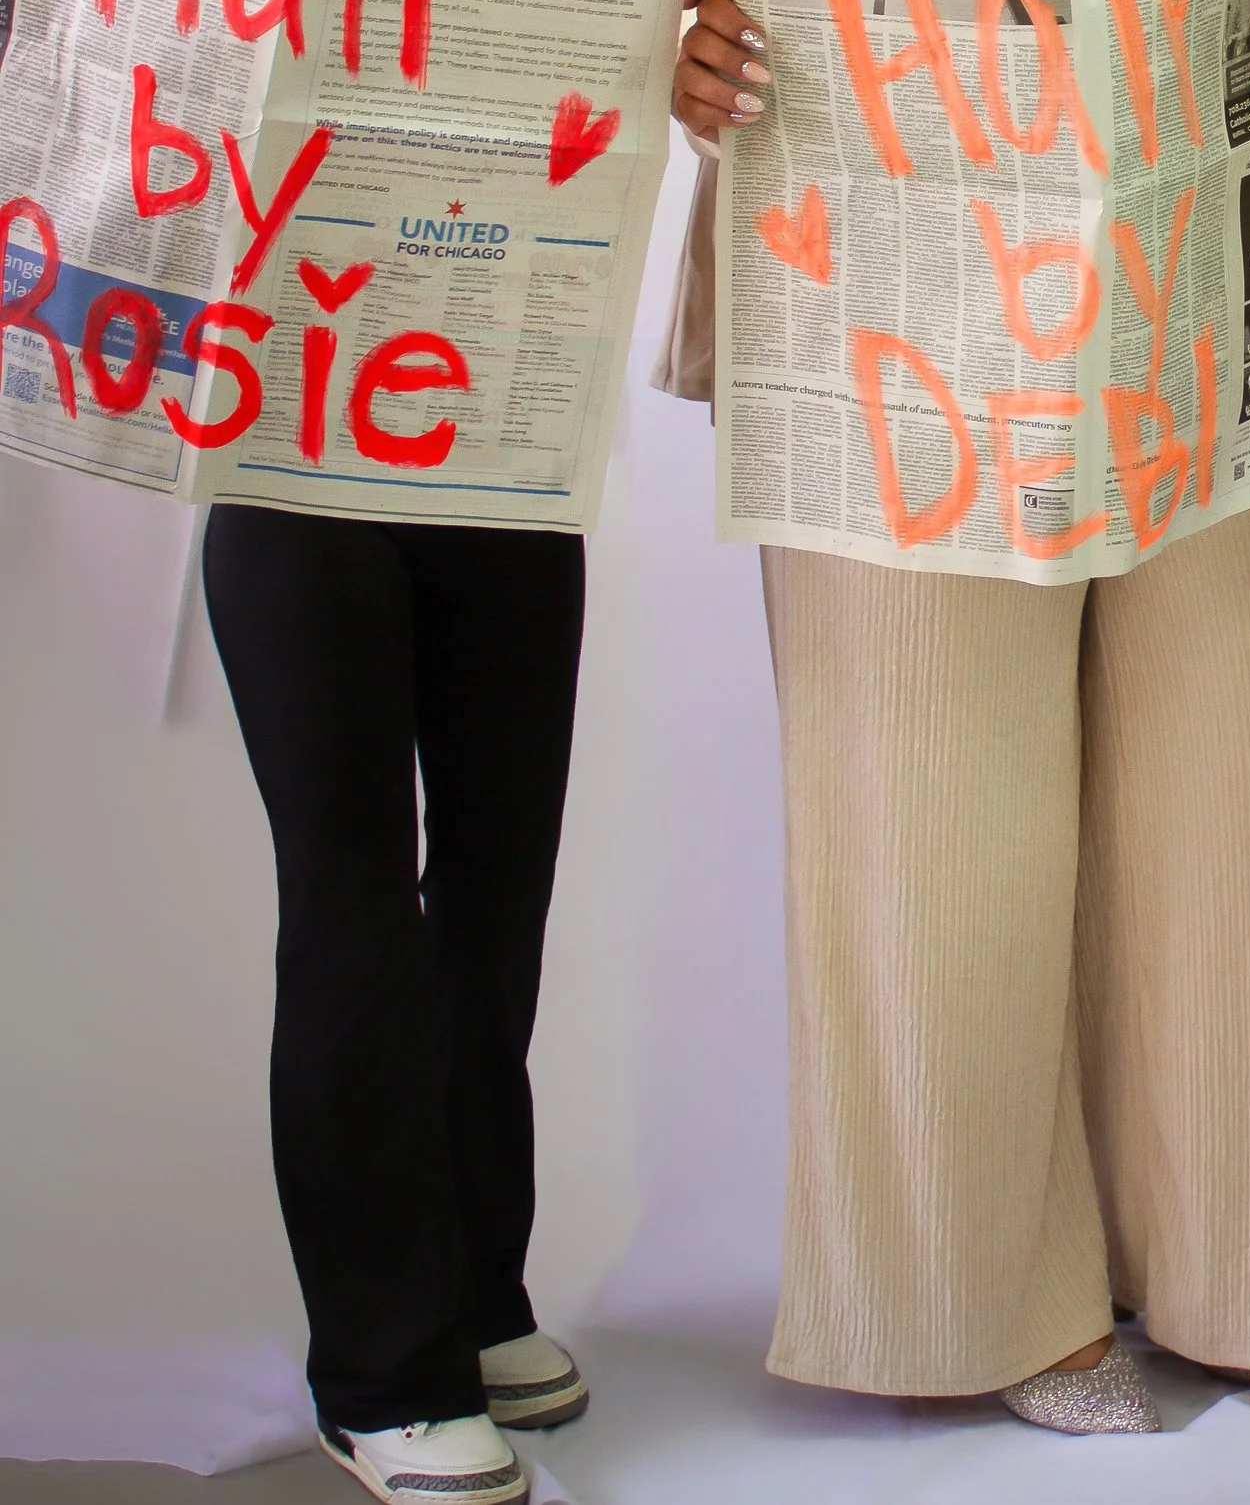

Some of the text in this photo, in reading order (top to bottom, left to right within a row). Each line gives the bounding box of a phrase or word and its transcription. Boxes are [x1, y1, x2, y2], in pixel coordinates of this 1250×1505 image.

[316, 119, 343, 129] While
[346, 122, 404, 134] immigration
[408, 129, 436, 139] policy
[440, 131, 446, 139] is
[450, 130, 489, 143] complex
[492, 138, 510, 146] and
[401, 139, 427, 149] these
[431, 142, 461, 152] tactics
[482, 148, 498, 156] not
[501, 150, 541, 160] welcome
[130, 64, 334, 295] by
[312, 180, 338, 188] UNITED
[356, 183, 390, 192] CHICAGO
[400, 216, 510, 244] UNITED
[396, 242, 506, 261] FOR CHICAGO
[970, 188, 1196, 396] by
[0, 197, 472, 467] Rosie
[23, 335, 45, 351] the
[731, 379, 764, 391] Aurora
[765, 382, 798, 394] teacher
[800, 385, 833, 399] charged
[834, 391, 850, 403] with
[909, 404, 920, 414] of
[1002, 416, 1055, 432] prosecutors
[1057, 422, 1073, 433] say
